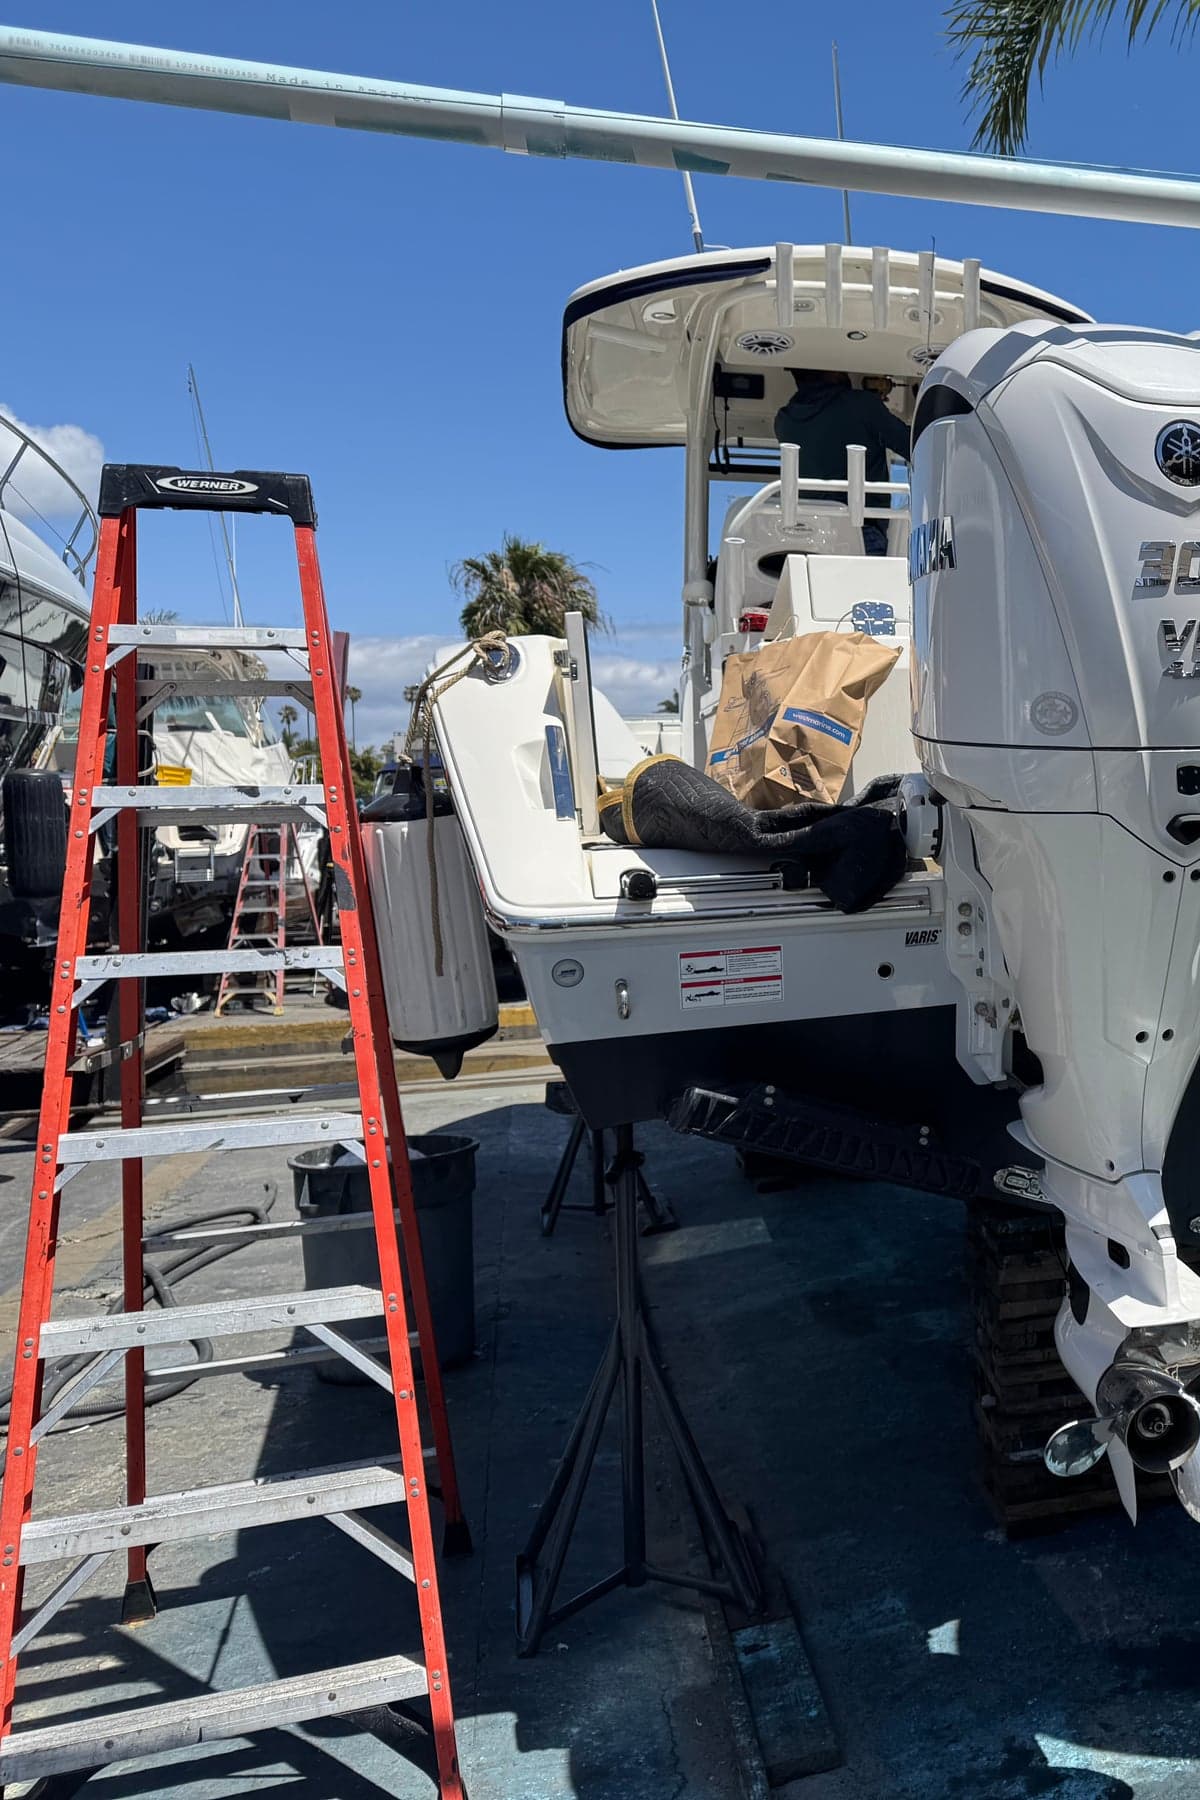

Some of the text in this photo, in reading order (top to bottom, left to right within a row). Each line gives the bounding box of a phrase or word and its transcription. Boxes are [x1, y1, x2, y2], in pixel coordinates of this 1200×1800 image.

[266, 73, 309, 85] Made
[177, 479, 240, 490] WERNER
[792, 712, 846, 739] westmarine.com
